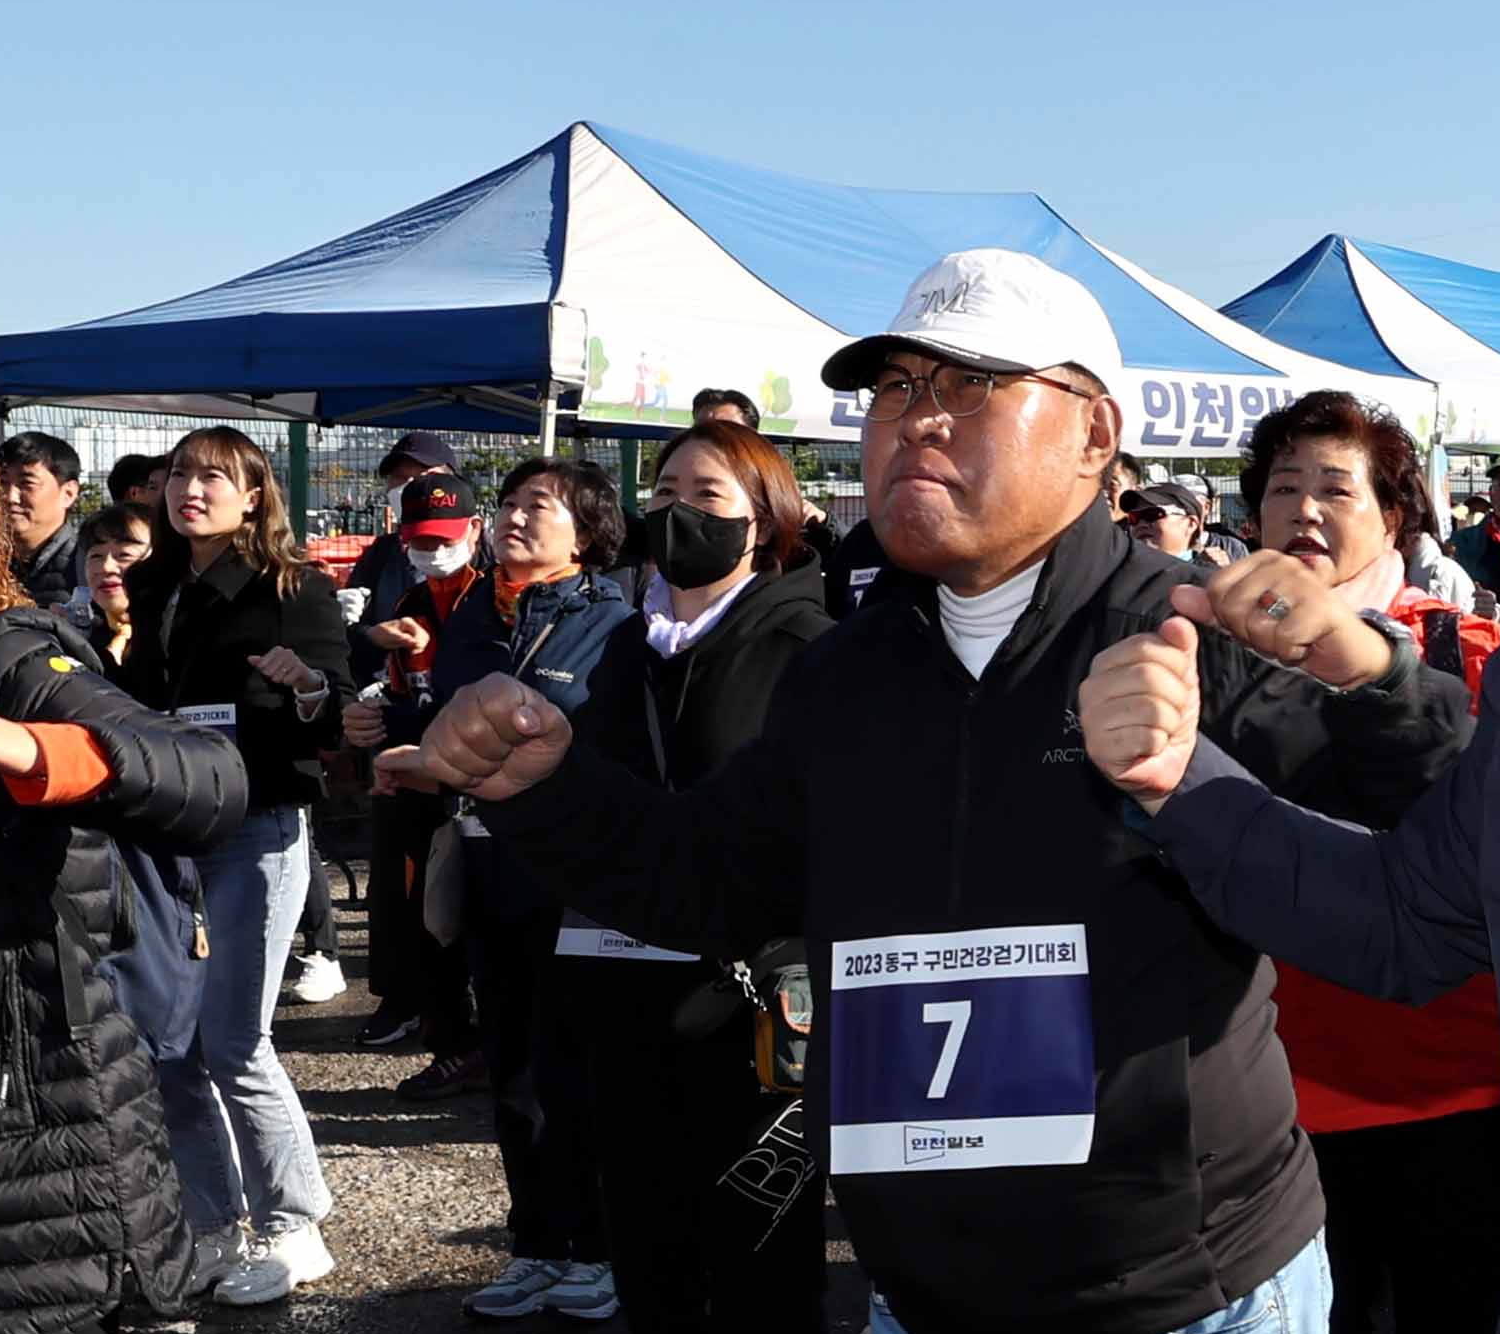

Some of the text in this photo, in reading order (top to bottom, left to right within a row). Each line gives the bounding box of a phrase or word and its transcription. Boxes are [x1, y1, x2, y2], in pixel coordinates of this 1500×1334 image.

[1140, 380, 1297, 448] 인천일
[845, 941, 1077, 977] 2023 동구 구민건강걷기대회
[922, 999, 973, 1100] 7
[910, 1135, 986, 1151] 인천일보
